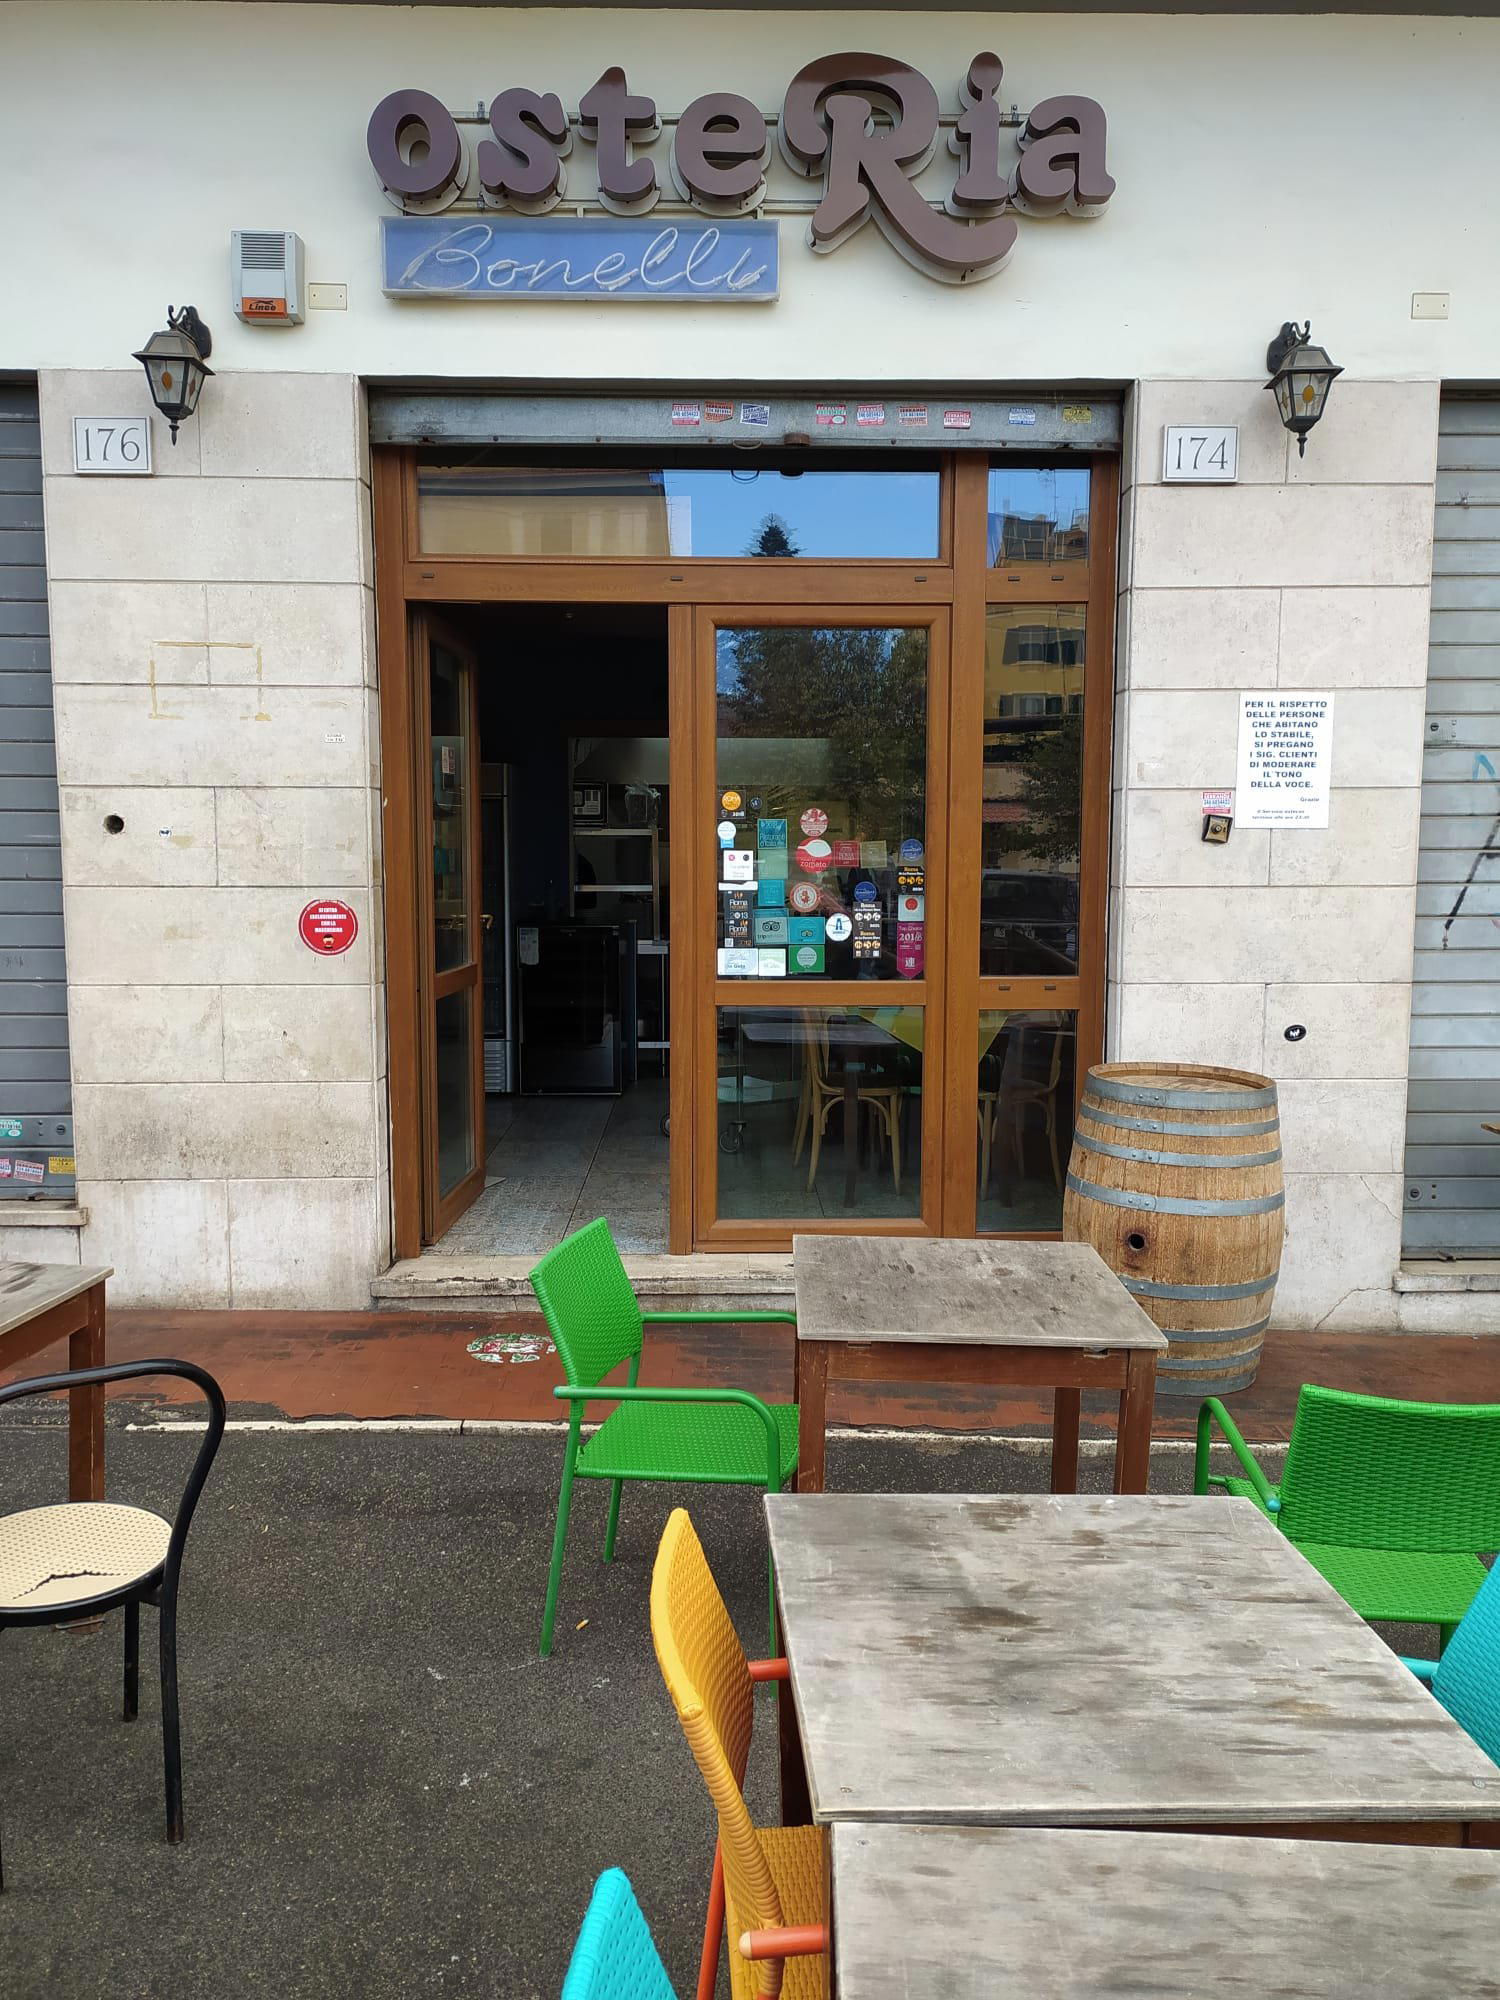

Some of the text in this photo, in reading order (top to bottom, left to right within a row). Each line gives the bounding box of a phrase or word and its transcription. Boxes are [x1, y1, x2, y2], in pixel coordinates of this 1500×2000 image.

[366, 51, 1117, 284] osteRia
[84, 427, 141, 462] 176
[1175, 436, 1228, 470] 174
[1255, 731, 1314, 739] LO STABILE,
